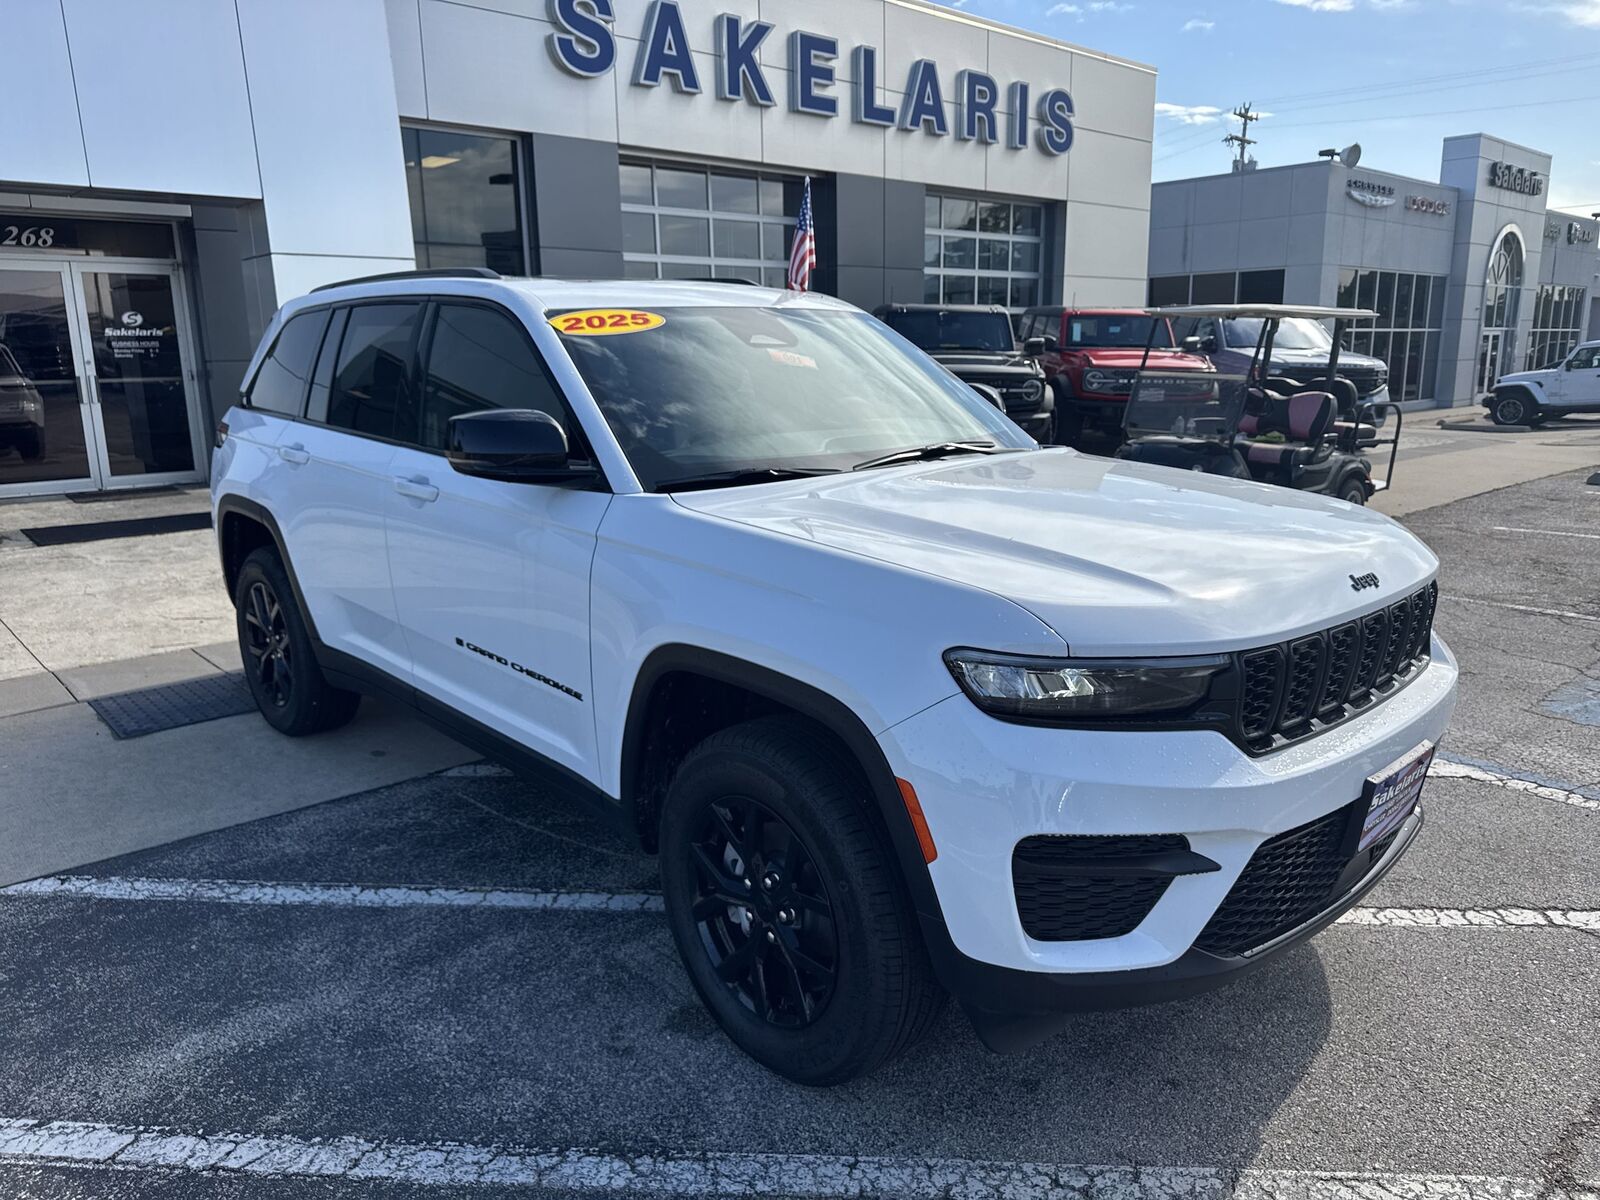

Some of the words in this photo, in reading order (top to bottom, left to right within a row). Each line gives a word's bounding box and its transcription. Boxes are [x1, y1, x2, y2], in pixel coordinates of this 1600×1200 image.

[545, 0, 1077, 156] SAKELARIS
[1490, 161, 1543, 196] Sakelaris
[2, 225, 55, 248] 268
[104, 327, 163, 337] Sakelaris
[562, 313, 652, 331] 2025
[1348, 572, 1380, 591] Jeep
[466, 642, 508, 666] GRAND
[510, 662, 583, 702] CHEROKEE
[1370, 763, 1427, 811] Sakelaris
